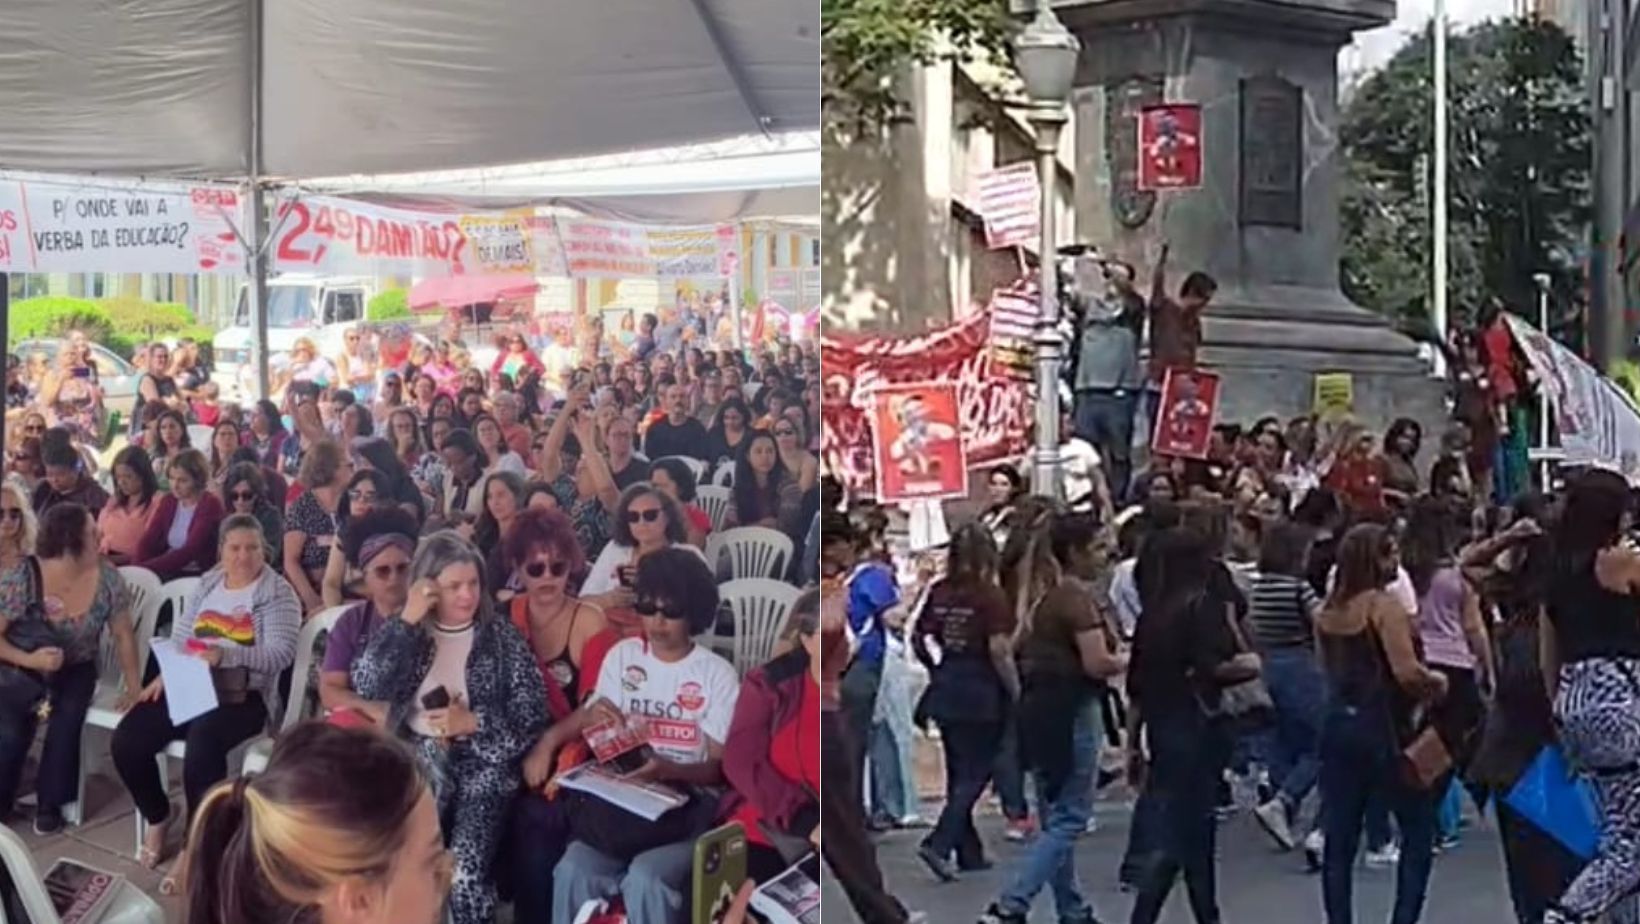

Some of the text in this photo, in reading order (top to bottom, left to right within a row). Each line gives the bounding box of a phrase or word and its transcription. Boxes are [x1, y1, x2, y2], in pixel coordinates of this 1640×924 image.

[76, 199, 118, 219] ONDE
[125, 199, 149, 217] VAI
[157, 198, 168, 216] A
[34, 221, 189, 252] VERBA DA EDUCAÇÃO?
